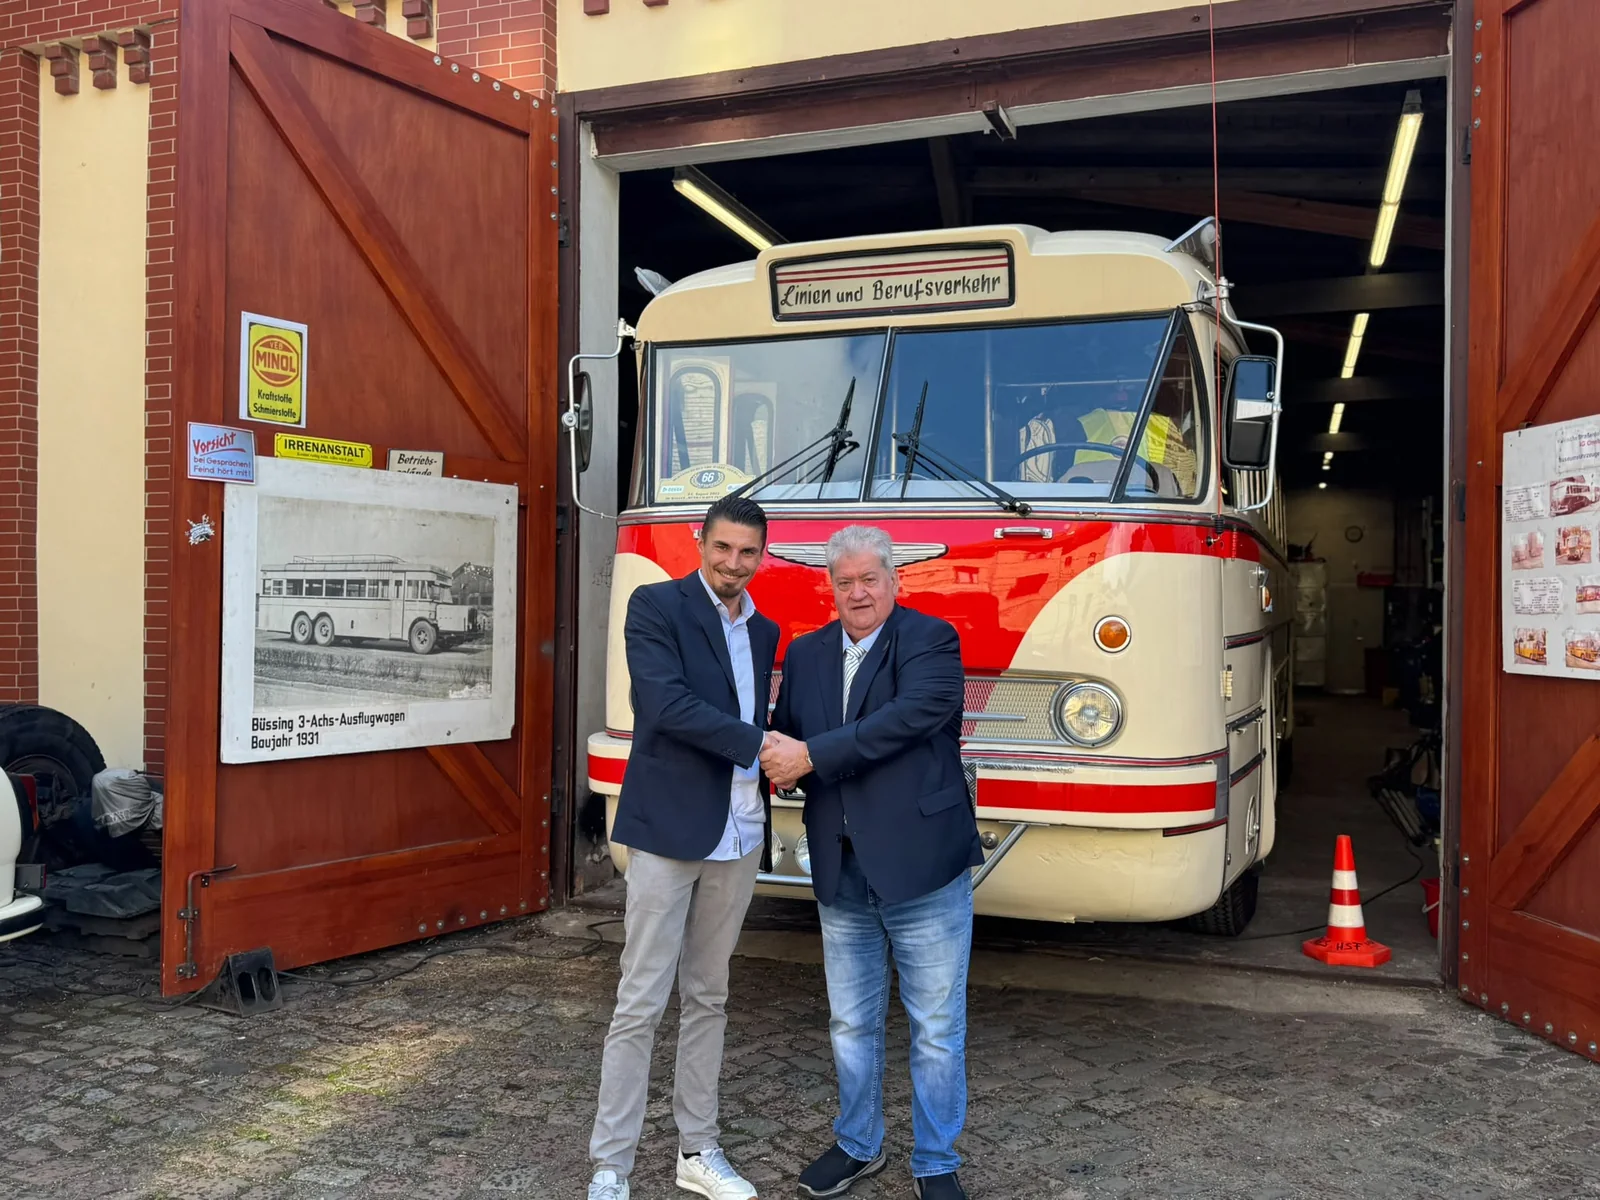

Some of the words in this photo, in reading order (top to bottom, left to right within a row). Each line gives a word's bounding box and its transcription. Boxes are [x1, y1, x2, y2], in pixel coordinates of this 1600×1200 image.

[780, 285, 831, 307] Linien
[836, 286, 864, 302] und
[872, 273, 1001, 300] Berufsverkehr
[269, 341, 284, 350] VEB
[256, 350, 296, 373] MINOL
[257, 389, 293, 404] Kraftstoffe
[253, 402, 297, 418] Schmierstoffe
[193, 432, 236, 455] Vorsicht
[284, 439, 365, 458] IRRENANSTALT
[193, 456, 206, 464] bei
[397, 453, 437, 465] Betriebs-
[193, 465, 215, 474] Feind
[217, 467, 234, 475] hört
[236, 469, 251, 477] mit!
[701, 472, 715, 482] 66
[251, 716, 294, 732] Büssing
[298, 711, 405, 729] 3-Achs-Ausflugwagen
[251, 734, 292, 750] Baujahr
[296, 731, 319, 746] 1931
